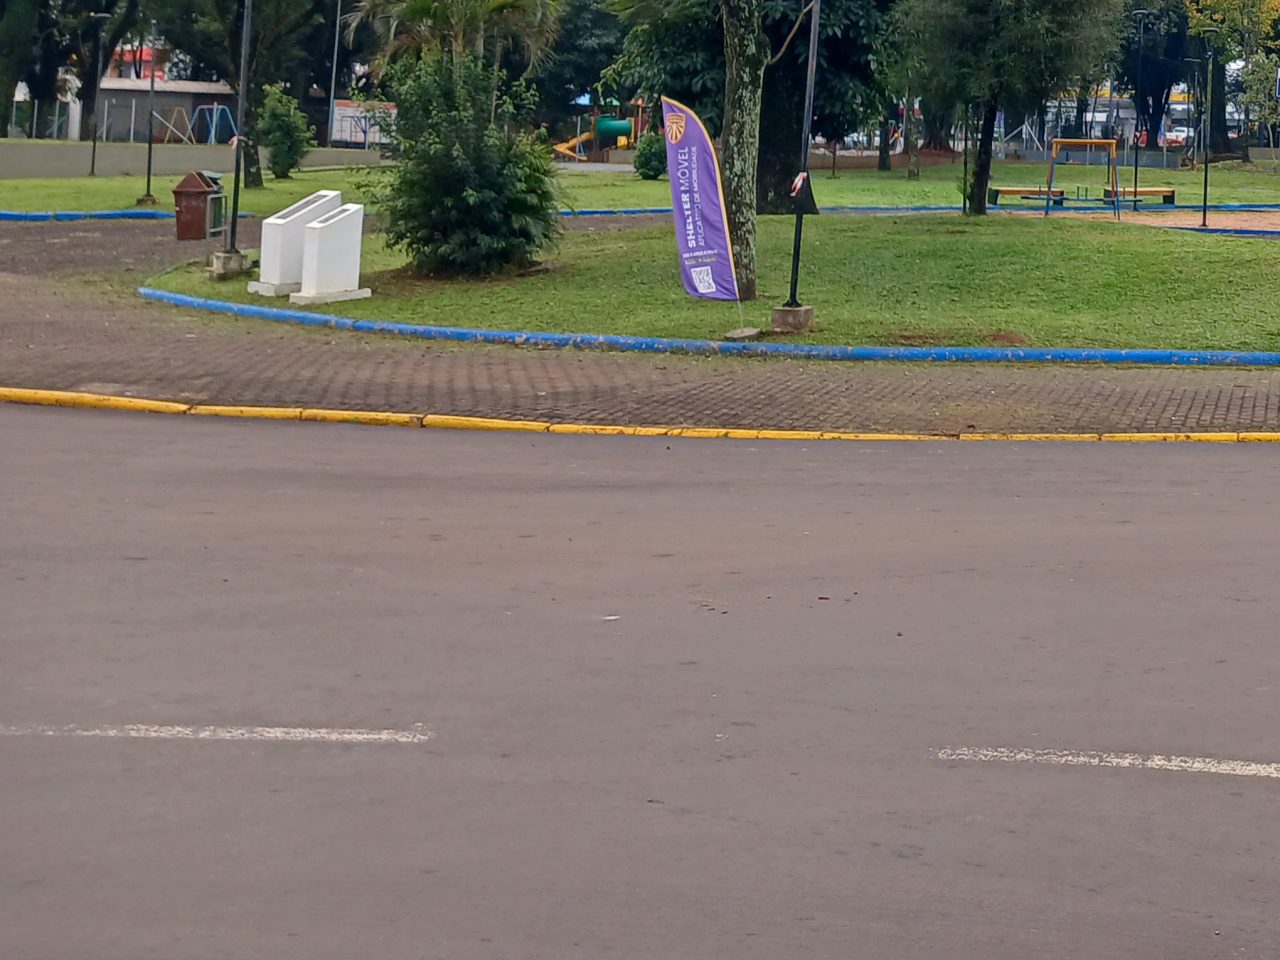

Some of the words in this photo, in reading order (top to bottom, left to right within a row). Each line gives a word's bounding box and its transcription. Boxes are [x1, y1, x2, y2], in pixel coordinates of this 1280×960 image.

[678, 146, 690, 191] MÓVEL
[691, 146, 699, 192] MOBILIDADE
[693, 192, 700, 203] DE
[681, 193, 696, 248] SHELTER
[695, 204, 705, 246] APLICATIVO
